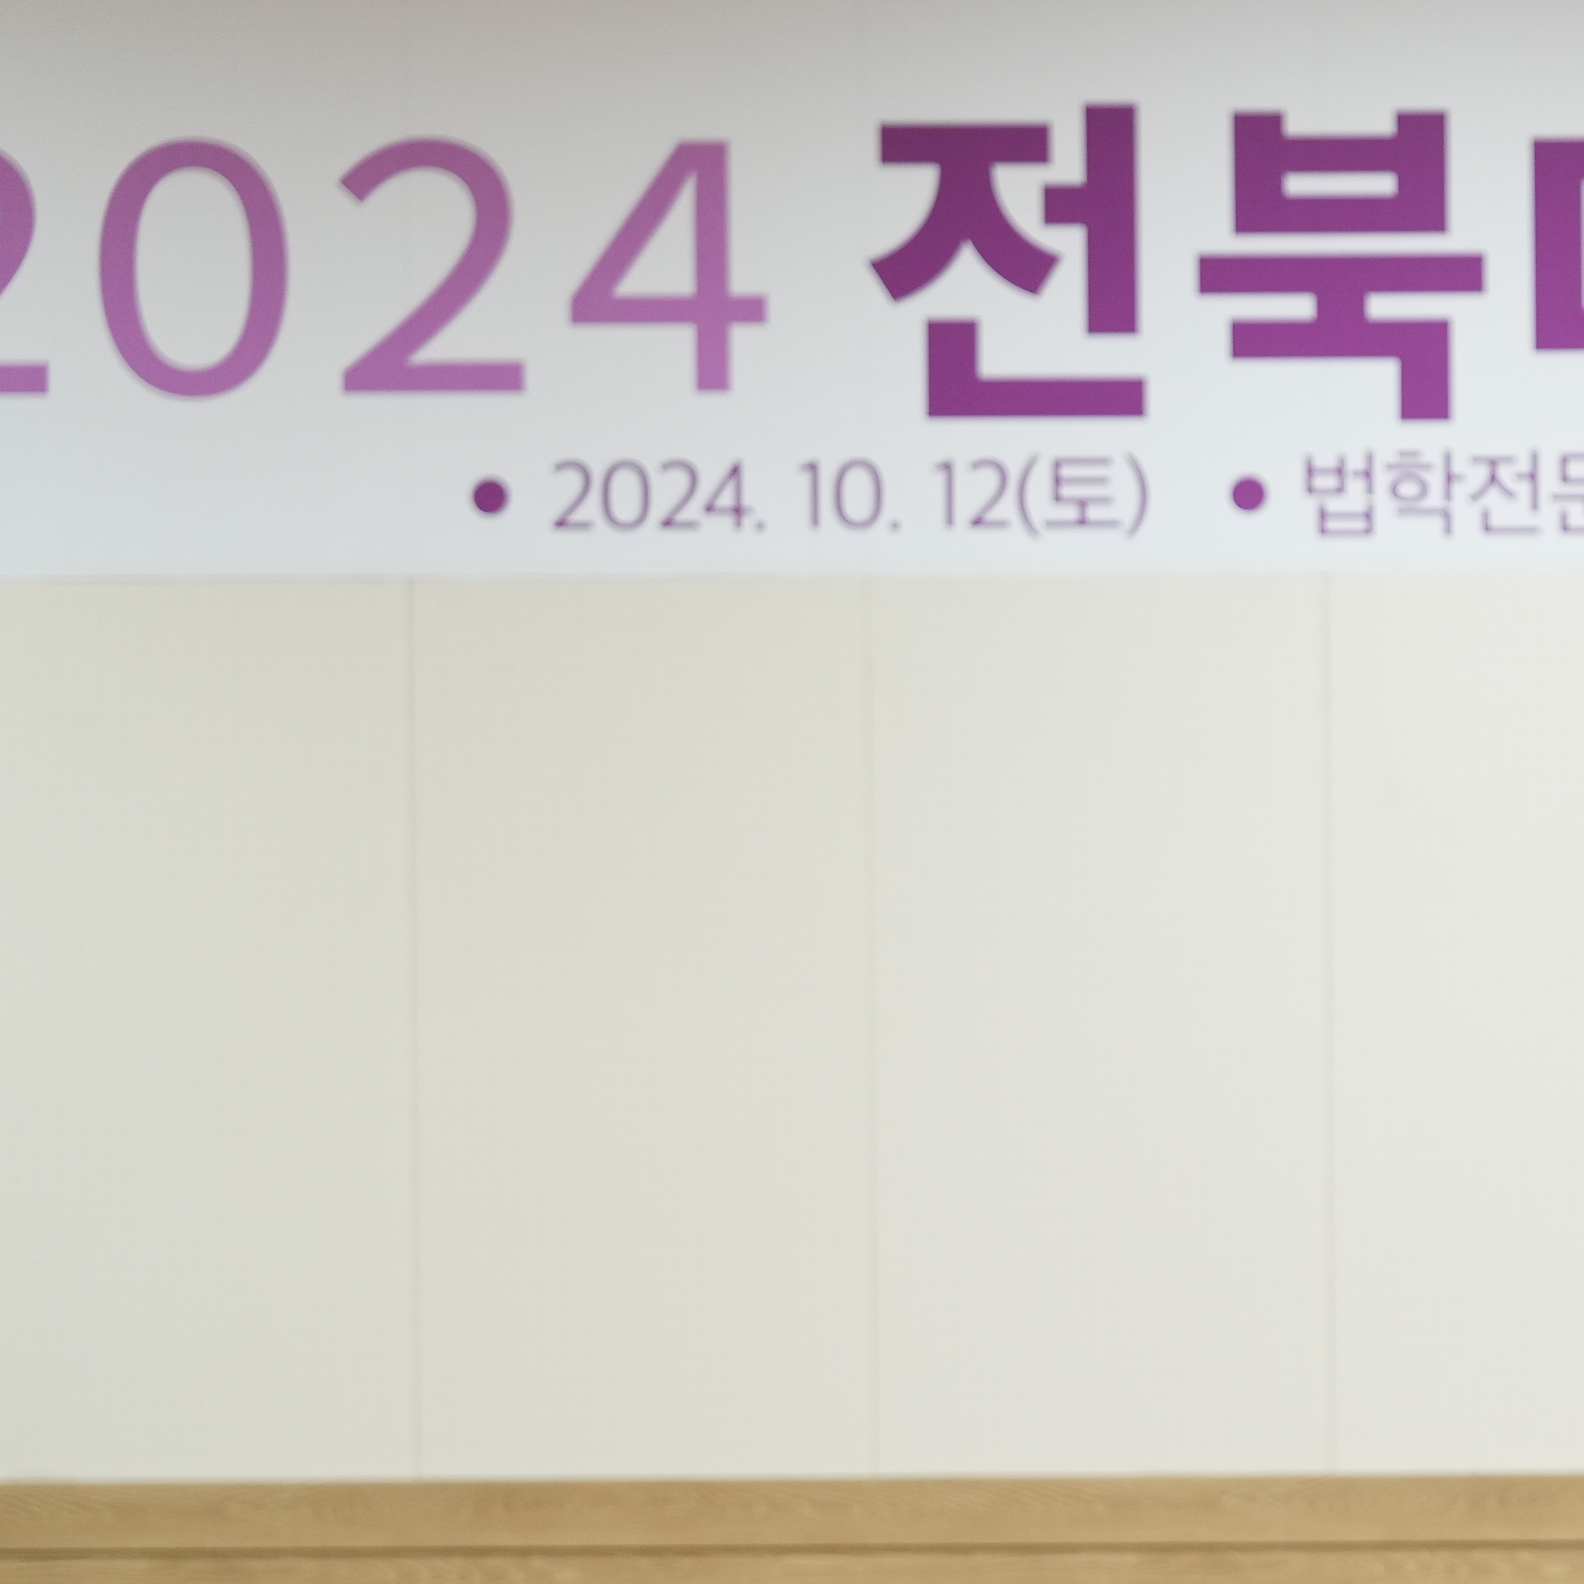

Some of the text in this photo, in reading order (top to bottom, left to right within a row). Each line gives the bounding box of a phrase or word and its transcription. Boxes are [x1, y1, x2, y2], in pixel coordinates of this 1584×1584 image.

[0, 136, 770, 401] 024
[552, 456, 1151, 537] 2024. 10. 12(토)
